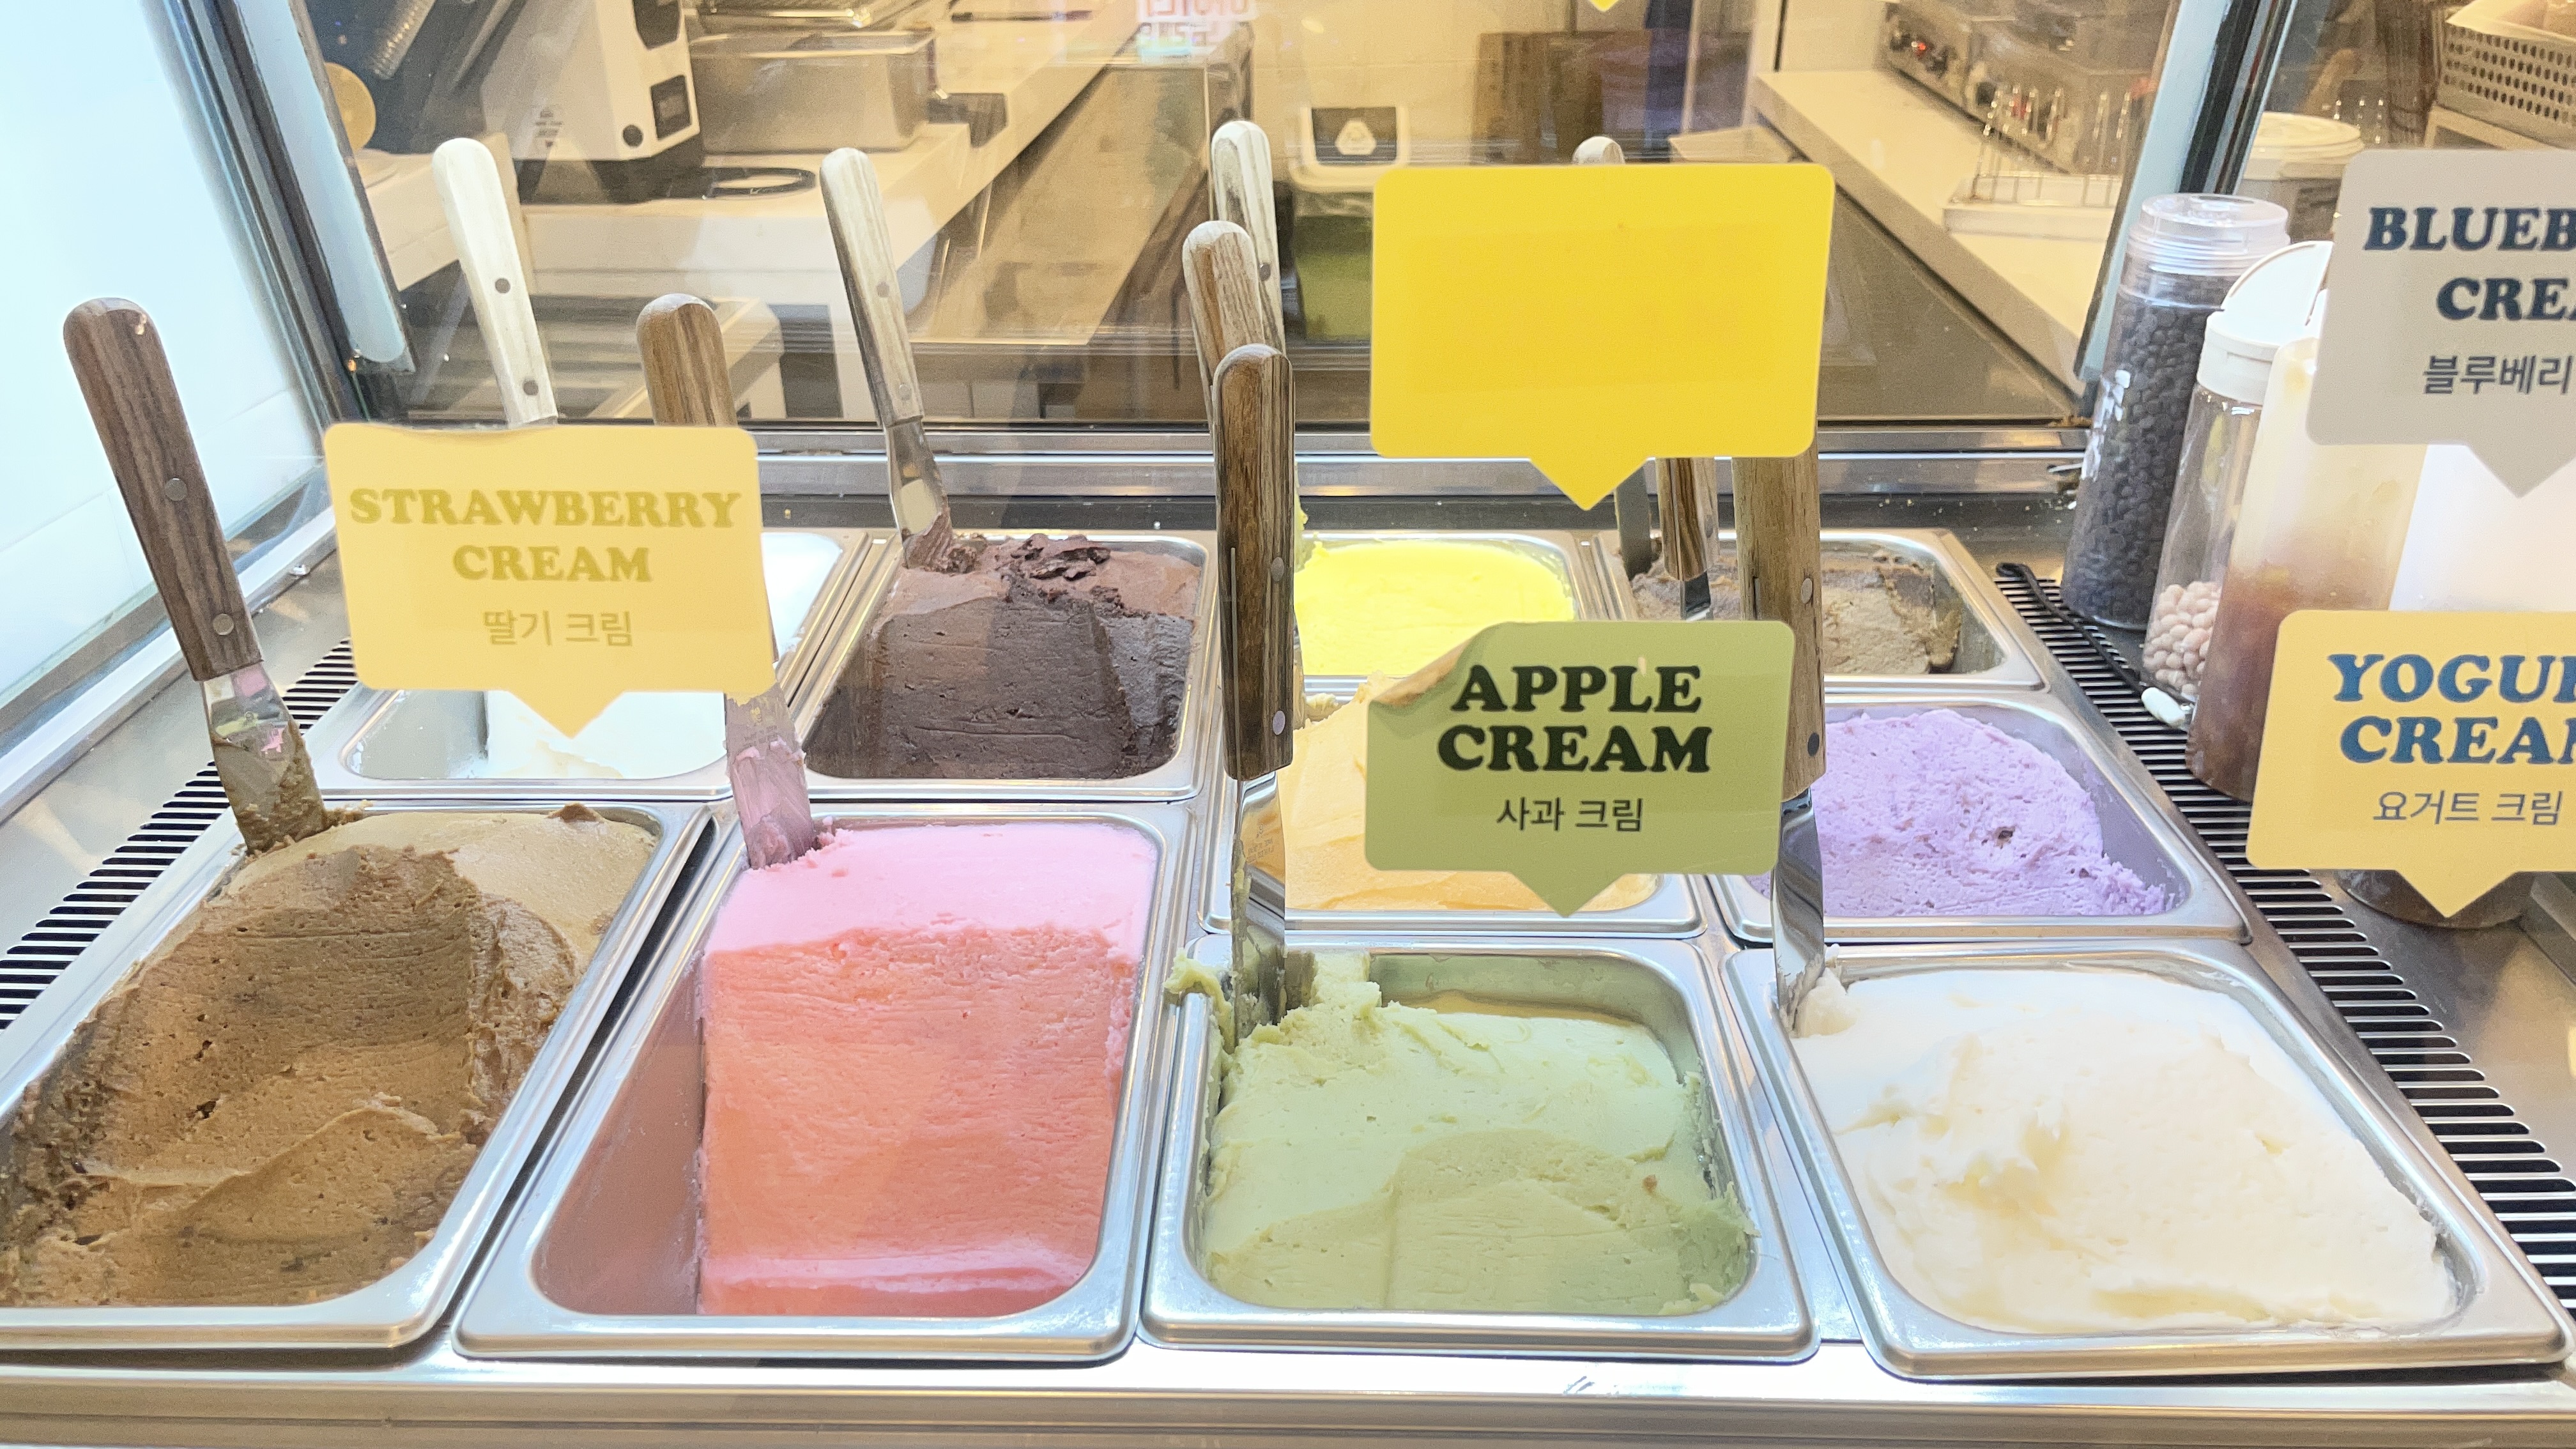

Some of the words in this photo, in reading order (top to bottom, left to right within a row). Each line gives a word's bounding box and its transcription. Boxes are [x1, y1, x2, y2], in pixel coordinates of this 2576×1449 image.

[2363, 206, 2576, 251] BLUEB
[2436, 277, 2576, 321] CRE
[2423, 355, 2573, 394] 블루베리
[349, 488, 741, 528] STRAWBERRY
[452, 544, 652, 583] CREAM
[483, 610, 552, 646] 딸기
[565, 610, 633, 647] 크림
[1449, 664, 1703, 714] APPLE
[1437, 724, 1713, 773] CREAM
[1496, 796, 1566, 832] 사과
[1575, 797, 1644, 832] 크림
[2373, 790, 2480, 825] 요거트
[2491, 790, 2563, 826] 크림
